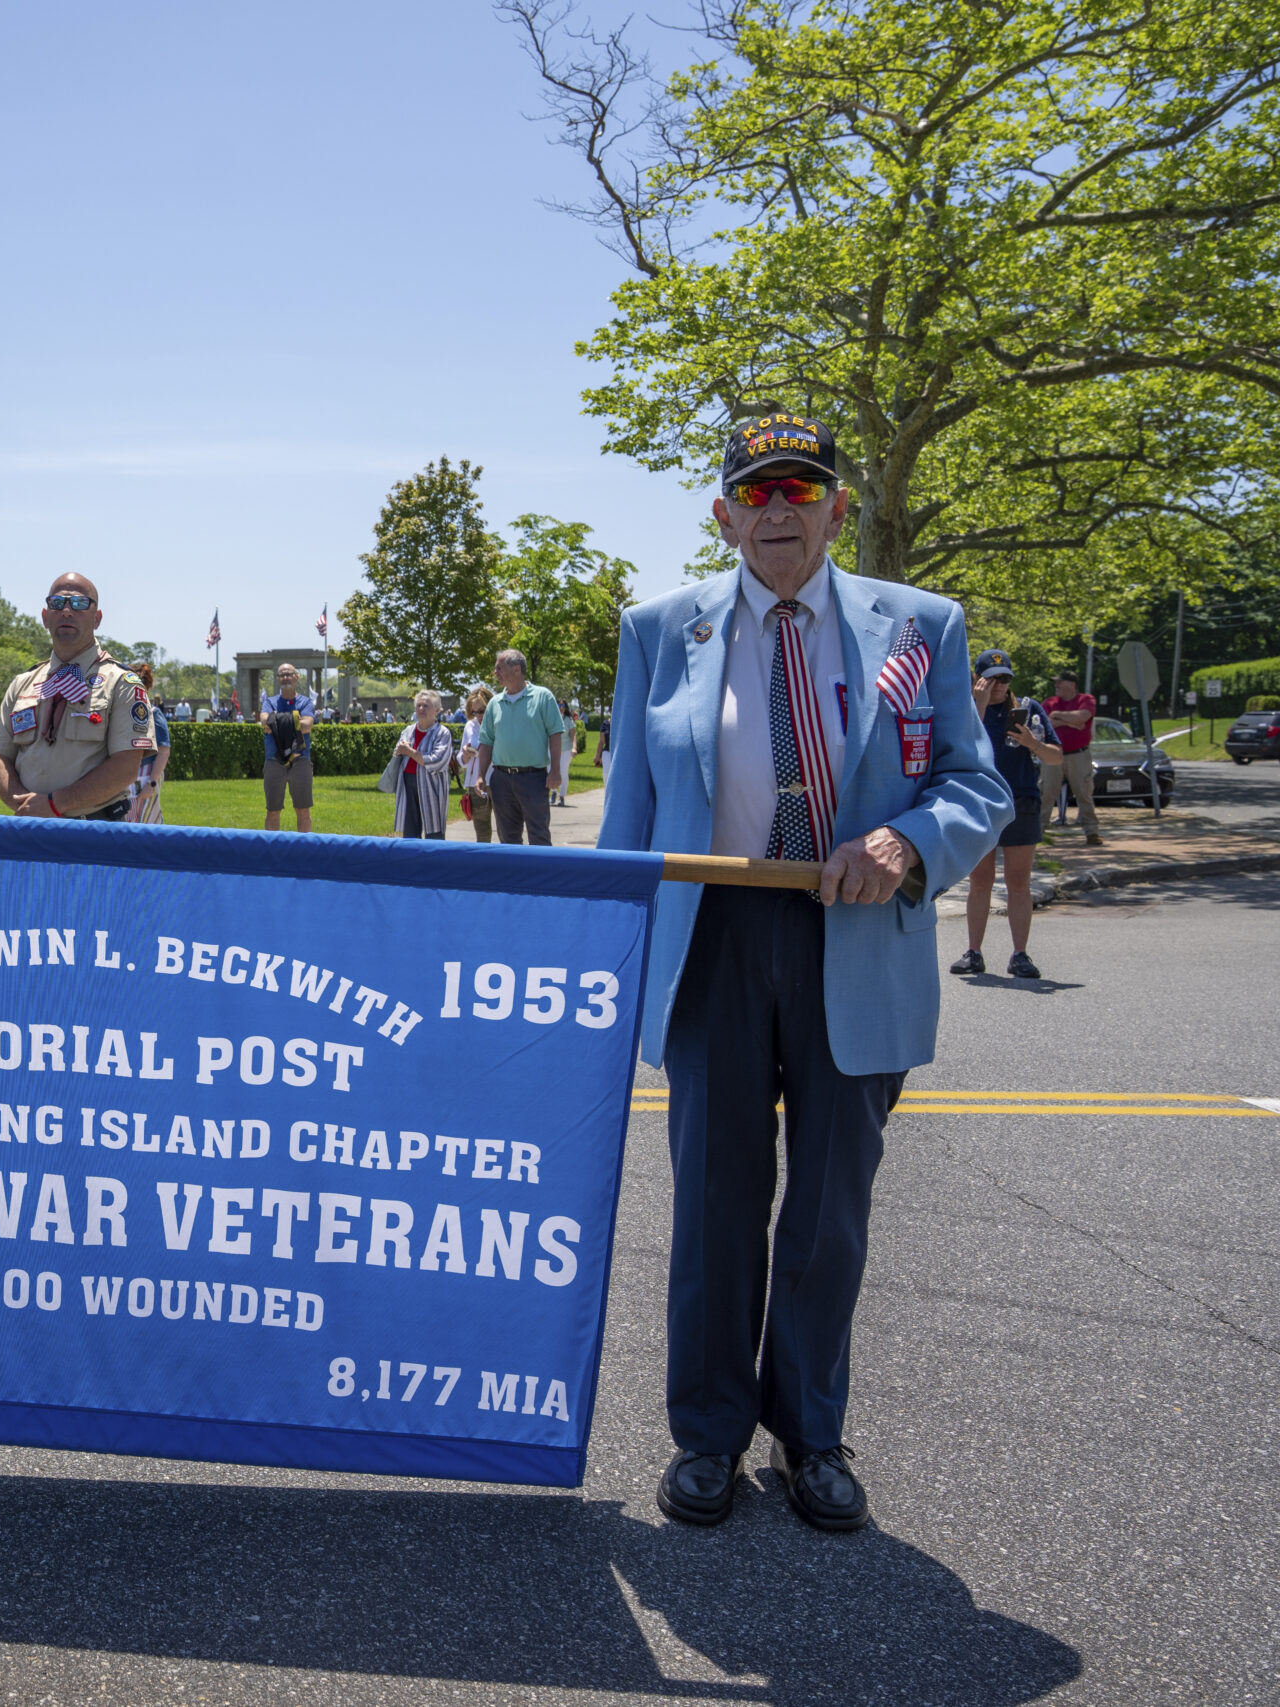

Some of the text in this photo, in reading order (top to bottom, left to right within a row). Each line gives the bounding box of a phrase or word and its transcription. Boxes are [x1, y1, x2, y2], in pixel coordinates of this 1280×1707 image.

[743, 414, 819, 439] KOREA
[747, 438, 820, 457] VETERAN
[94, 929, 136, 972] L.
[154, 935, 424, 1047] BECKWITH
[439, 961, 620, 1030] 1953
[195, 1035, 365, 1092] POST
[80, 1107, 271, 1160] ISLAND
[289, 1120, 541, 1185] CHAPTER
[156, 1181, 581, 1287] VETERANS
[81, 1275, 325, 1332] WOUNDED
[327, 1356, 570, 1422] 8,177 MIA
